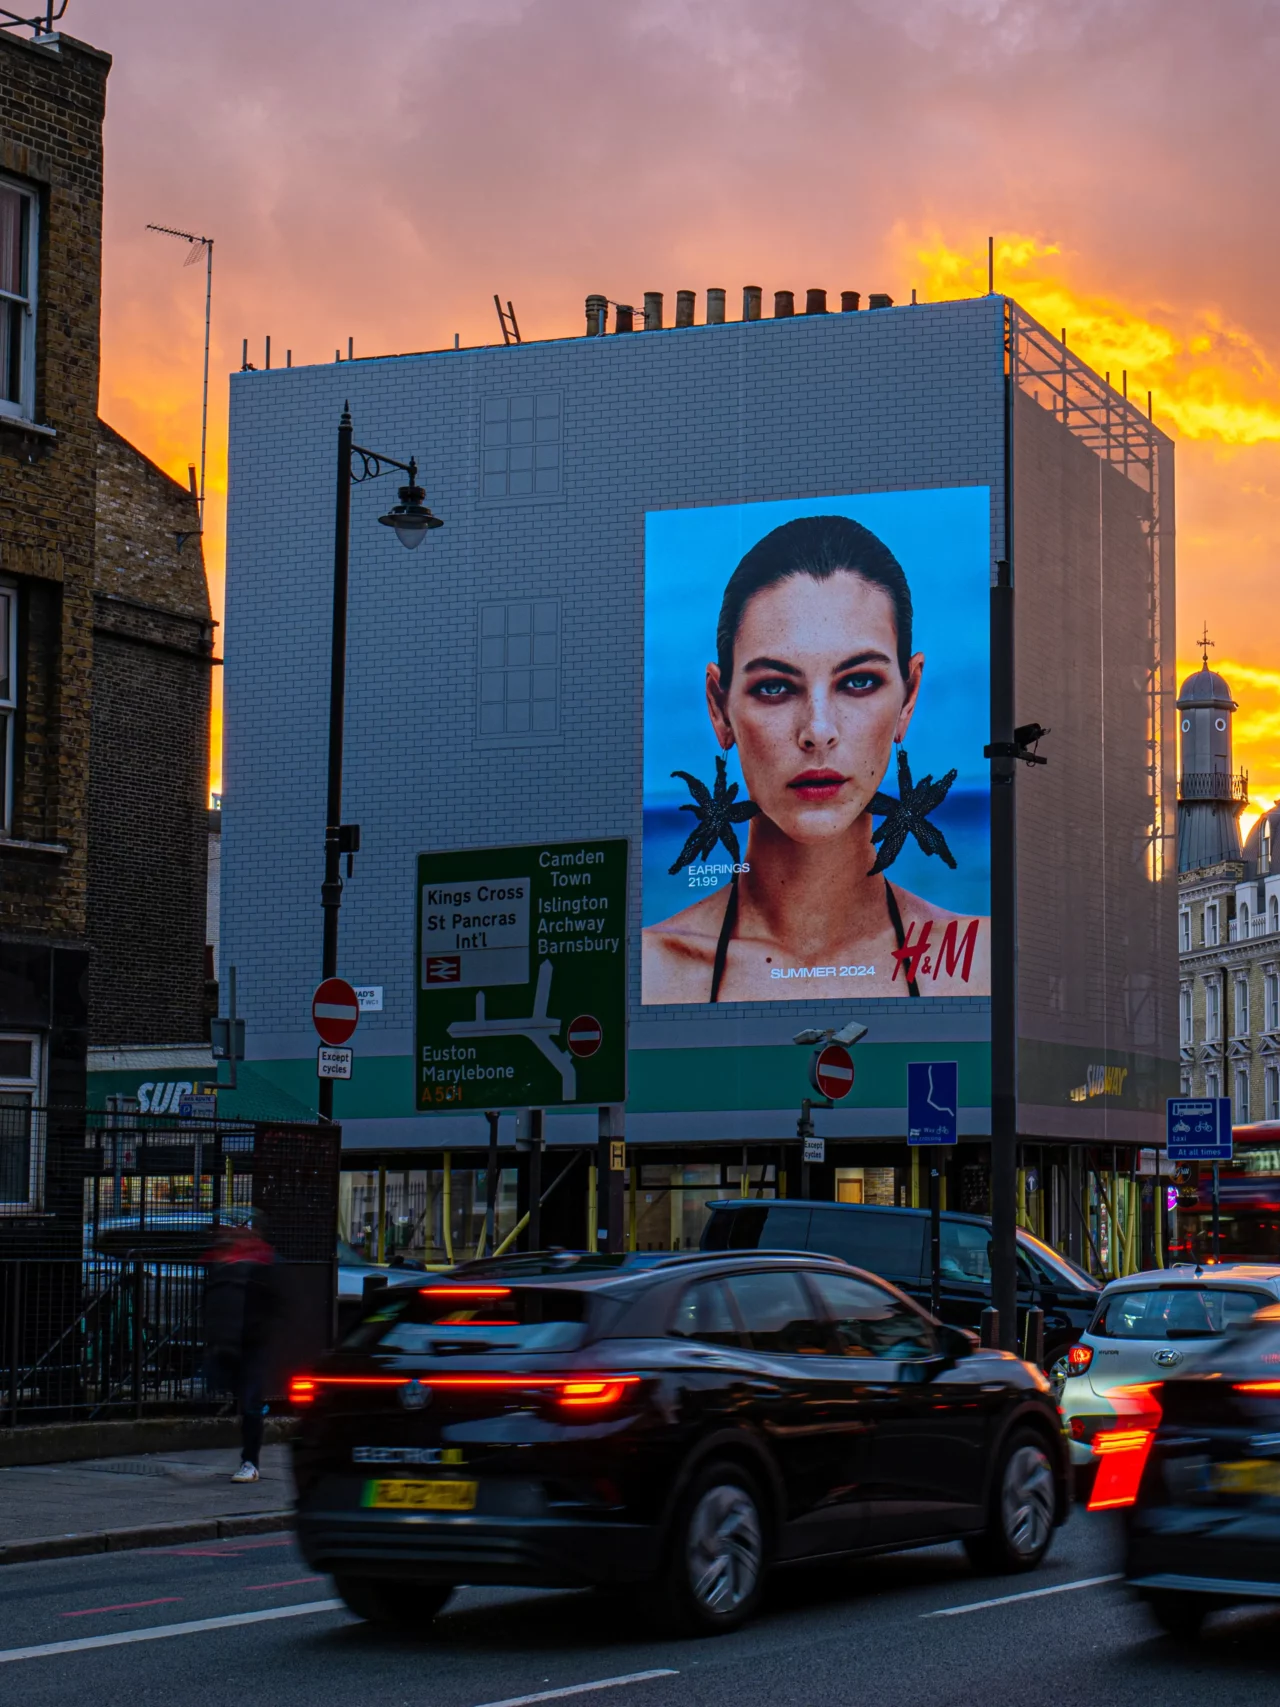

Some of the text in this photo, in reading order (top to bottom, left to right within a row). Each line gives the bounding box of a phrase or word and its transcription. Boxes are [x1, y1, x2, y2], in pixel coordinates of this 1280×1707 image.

[538, 850, 605, 868] Camden
[688, 862, 750, 876] EARRINGS
[550, 871, 591, 887] Town
[688, 876, 718, 887] 21.99
[427, 886, 524, 907] Kings Cross
[538, 895, 608, 914] Islington
[427, 912, 516, 931] St Pancras
[537, 918, 605, 934] Archway
[456, 932, 487, 949] Int'l
[538, 936, 620, 955] Barnsbury
[892, 919, 980, 983] H&M
[770, 965, 876, 980] SUMMER 2024
[355, 990, 375, 998] AD'S
[322, 1051, 349, 1063] Except
[422, 1045, 476, 1062] Euston
[322, 1064, 347, 1074] cycles
[422, 1064, 514, 1084] Marylebone
[804, 1141, 823, 1150] Except
[1200, 1147, 1221, 1156] times
[804, 1150, 822, 1158] cycles
